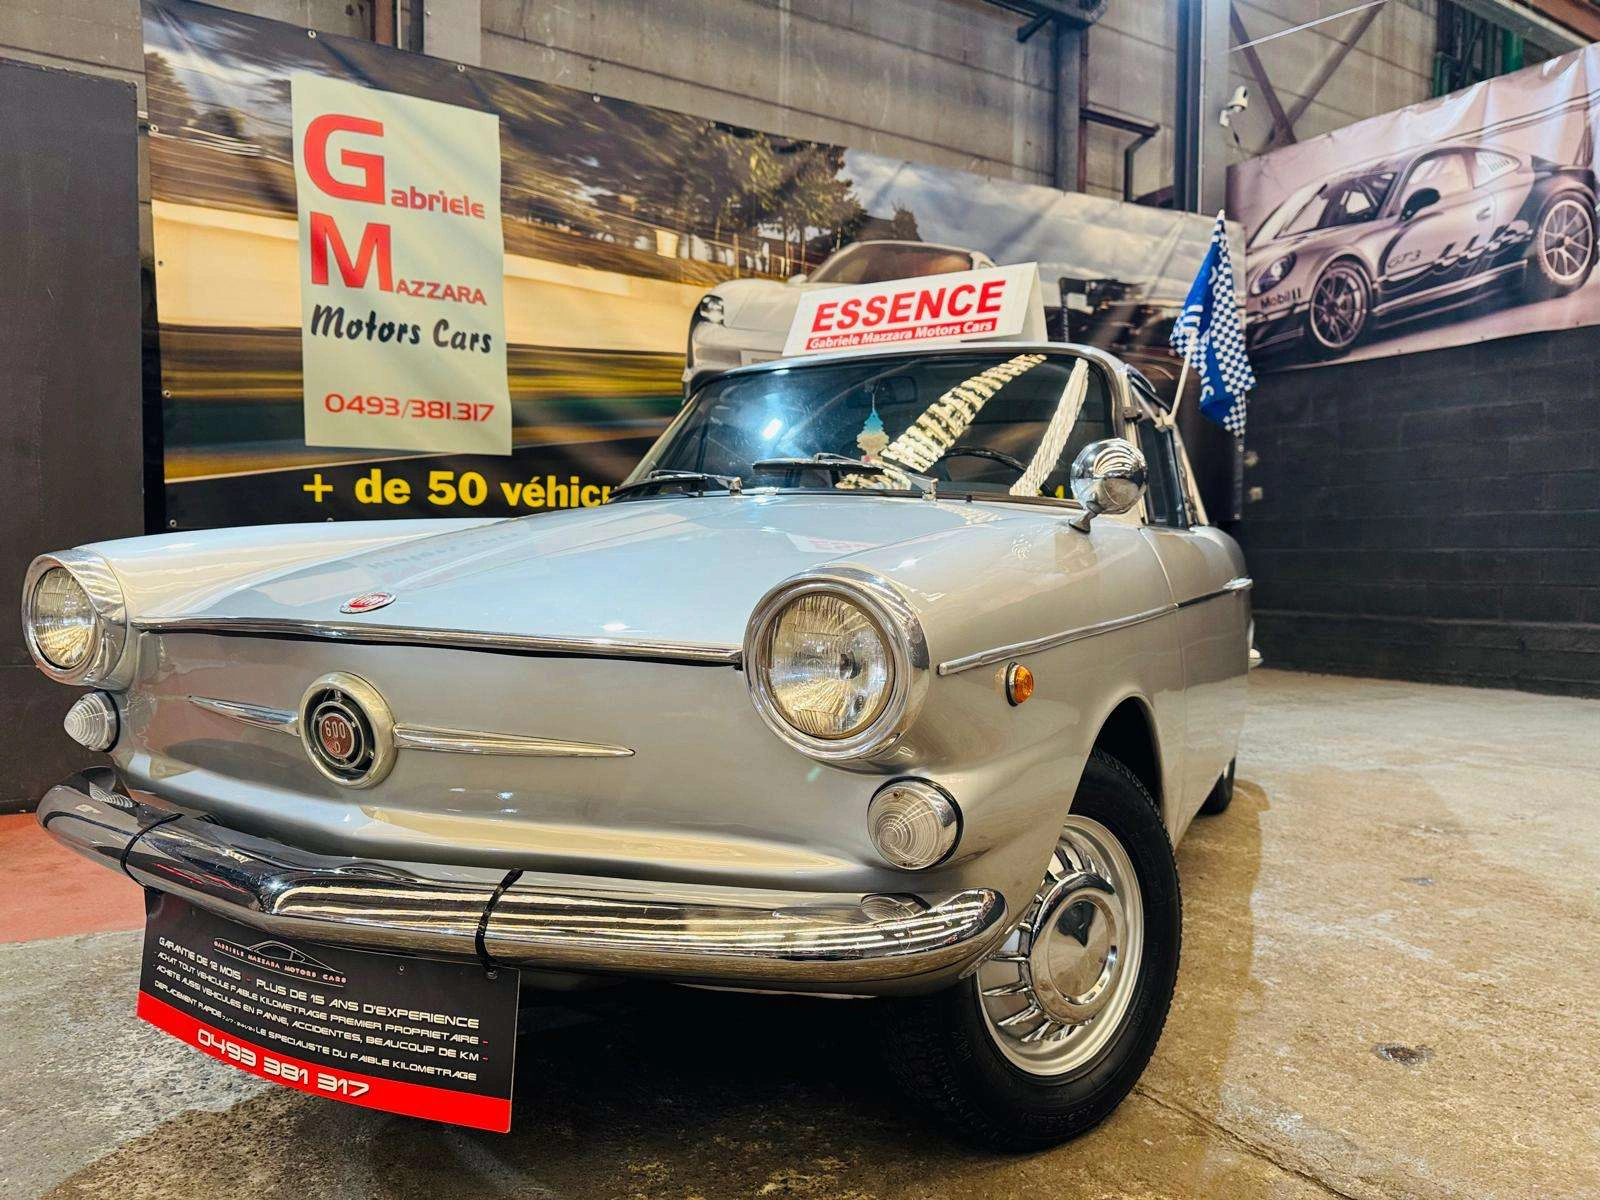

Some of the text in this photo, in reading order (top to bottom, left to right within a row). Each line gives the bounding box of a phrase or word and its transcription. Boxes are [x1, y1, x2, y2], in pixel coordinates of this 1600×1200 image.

[304, 113, 485, 219] Gabriele
[311, 303, 493, 354] Motors Cars
[811, 280, 1007, 333] ESSENCE
[809, 321, 993, 349] Gabriele Mazzara Motors Cars
[324, 393, 495, 423] 0493/381.317
[303, 473, 334, 503] +
[355, 468, 411, 505] de
[427, 470, 488, 507] 50
[325, 721, 346, 738] 600
[157, 952, 177, 967] ACHAT
[178, 959, 196, 974] TOUT
[196, 967, 229, 990] VEHICULE
[259, 994, 328, 1021] KILOMETRAGE
[330, 1015, 382, 1031] PREMIER
[384, 1023, 479, 1045] PROPRIETAIRE
[159, 937, 480, 1029] GARANTIE DE 12 MOIS PLUS DE 15 ANS D'EXPERIENCE
[285, 966, 317, 978] MOTORS
[322, 974, 347, 984] CARS
[154, 979, 198, 1008] DEPLACEMENT
[198, 1001, 223, 1018] RAPIDE
[255, 1026, 267, 1037] LE
[268, 1029, 330, 1055] SPECIALISTE
[332, 1048, 348, 1059] DU
[350, 1052, 390, 1068] FAIBLE
[392, 1060, 477, 1082] KILOMETRAGE
[156, 964, 480, 1062] ACHETE AUSSI VEHICULES EN PANNE, ACCIDENTES, BEAUCOUP DE KM
[197, 1028, 370, 1098] 0493 381 317
